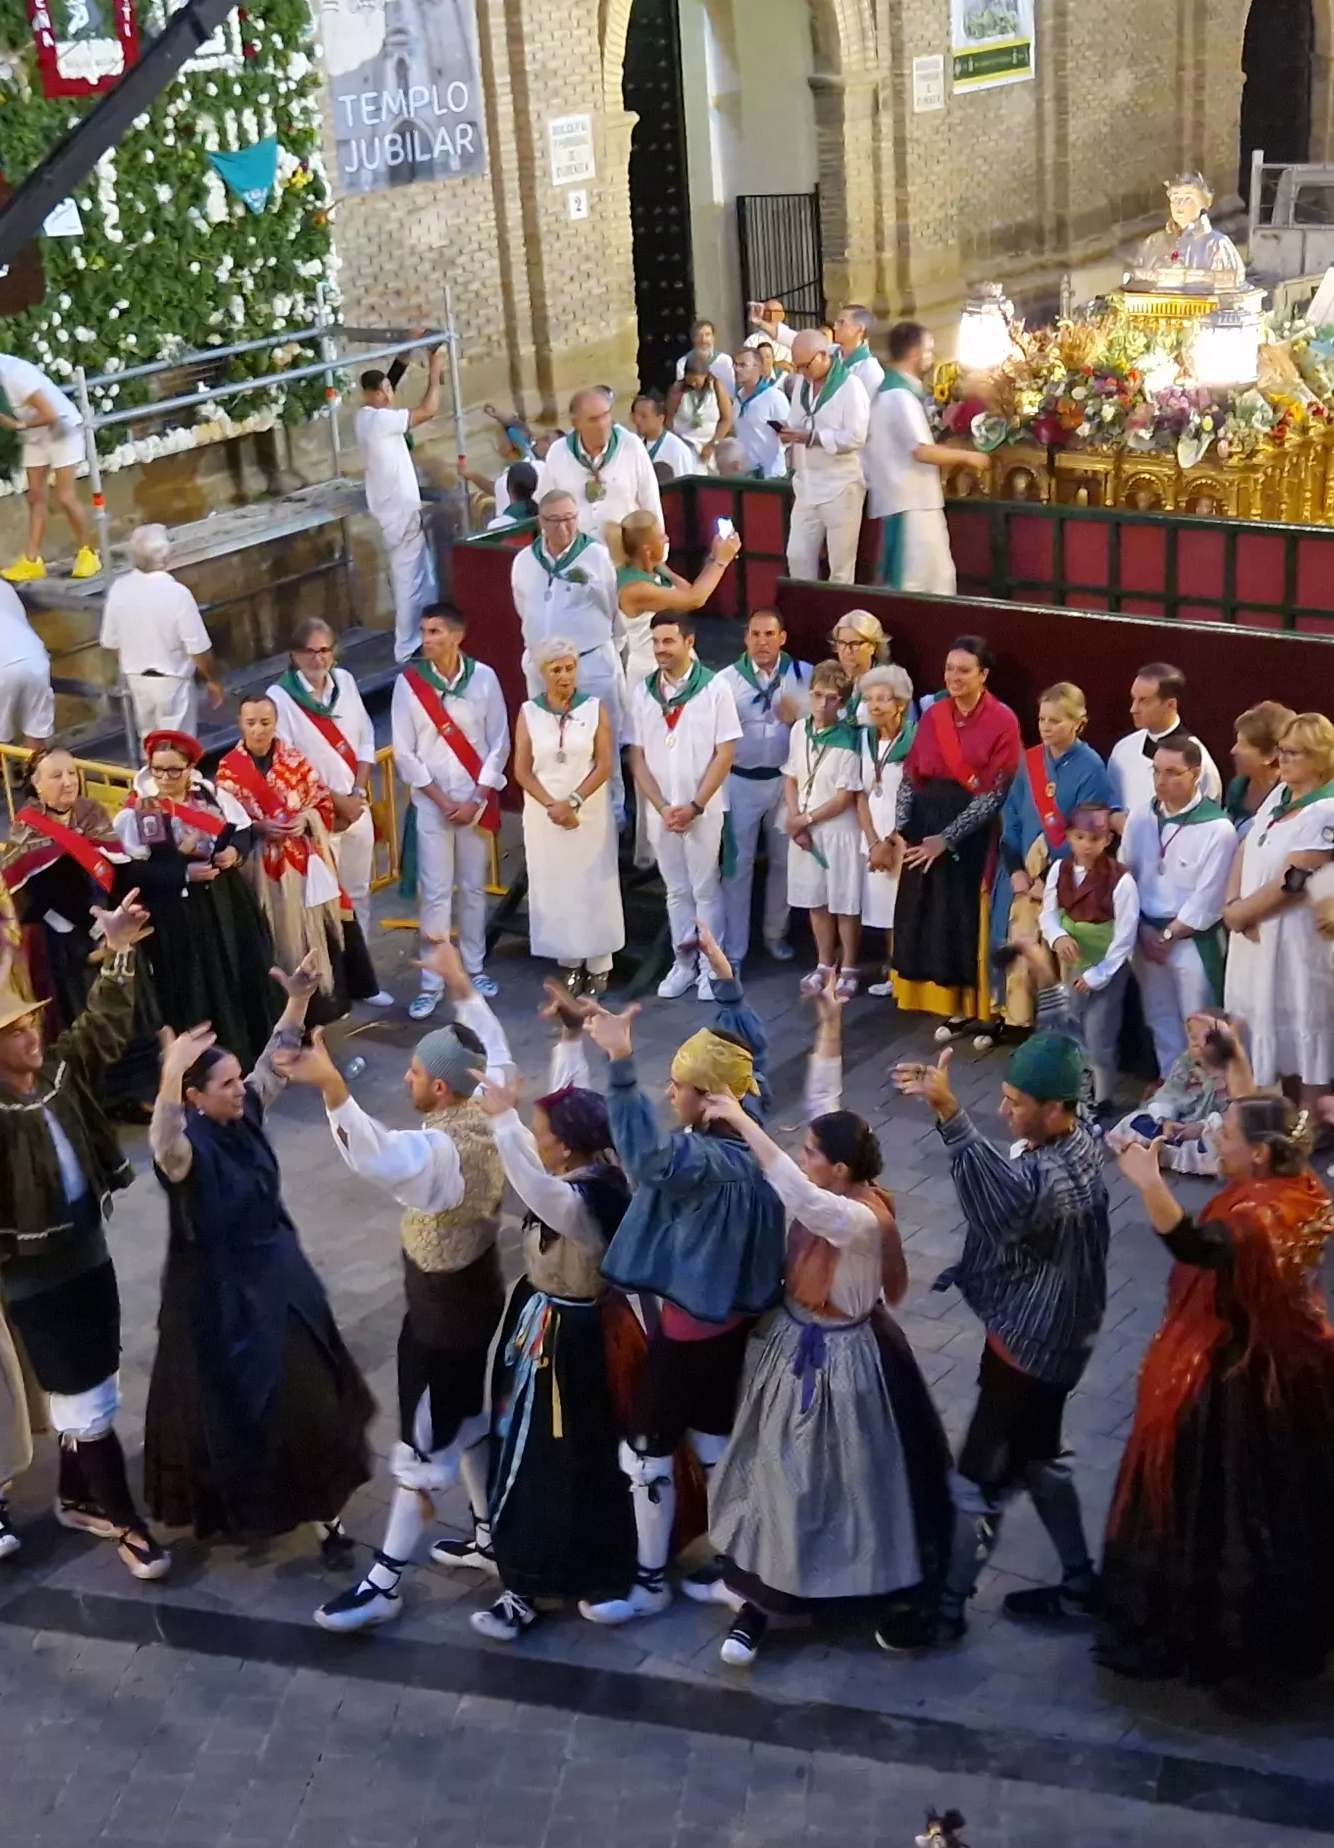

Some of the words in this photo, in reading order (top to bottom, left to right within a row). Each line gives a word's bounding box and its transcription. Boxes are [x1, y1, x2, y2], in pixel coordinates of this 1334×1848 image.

[338, 81, 468, 128] TEMPLO
[345, 123, 474, 173] JUBILAR
[573, 196, 582, 212] 2
